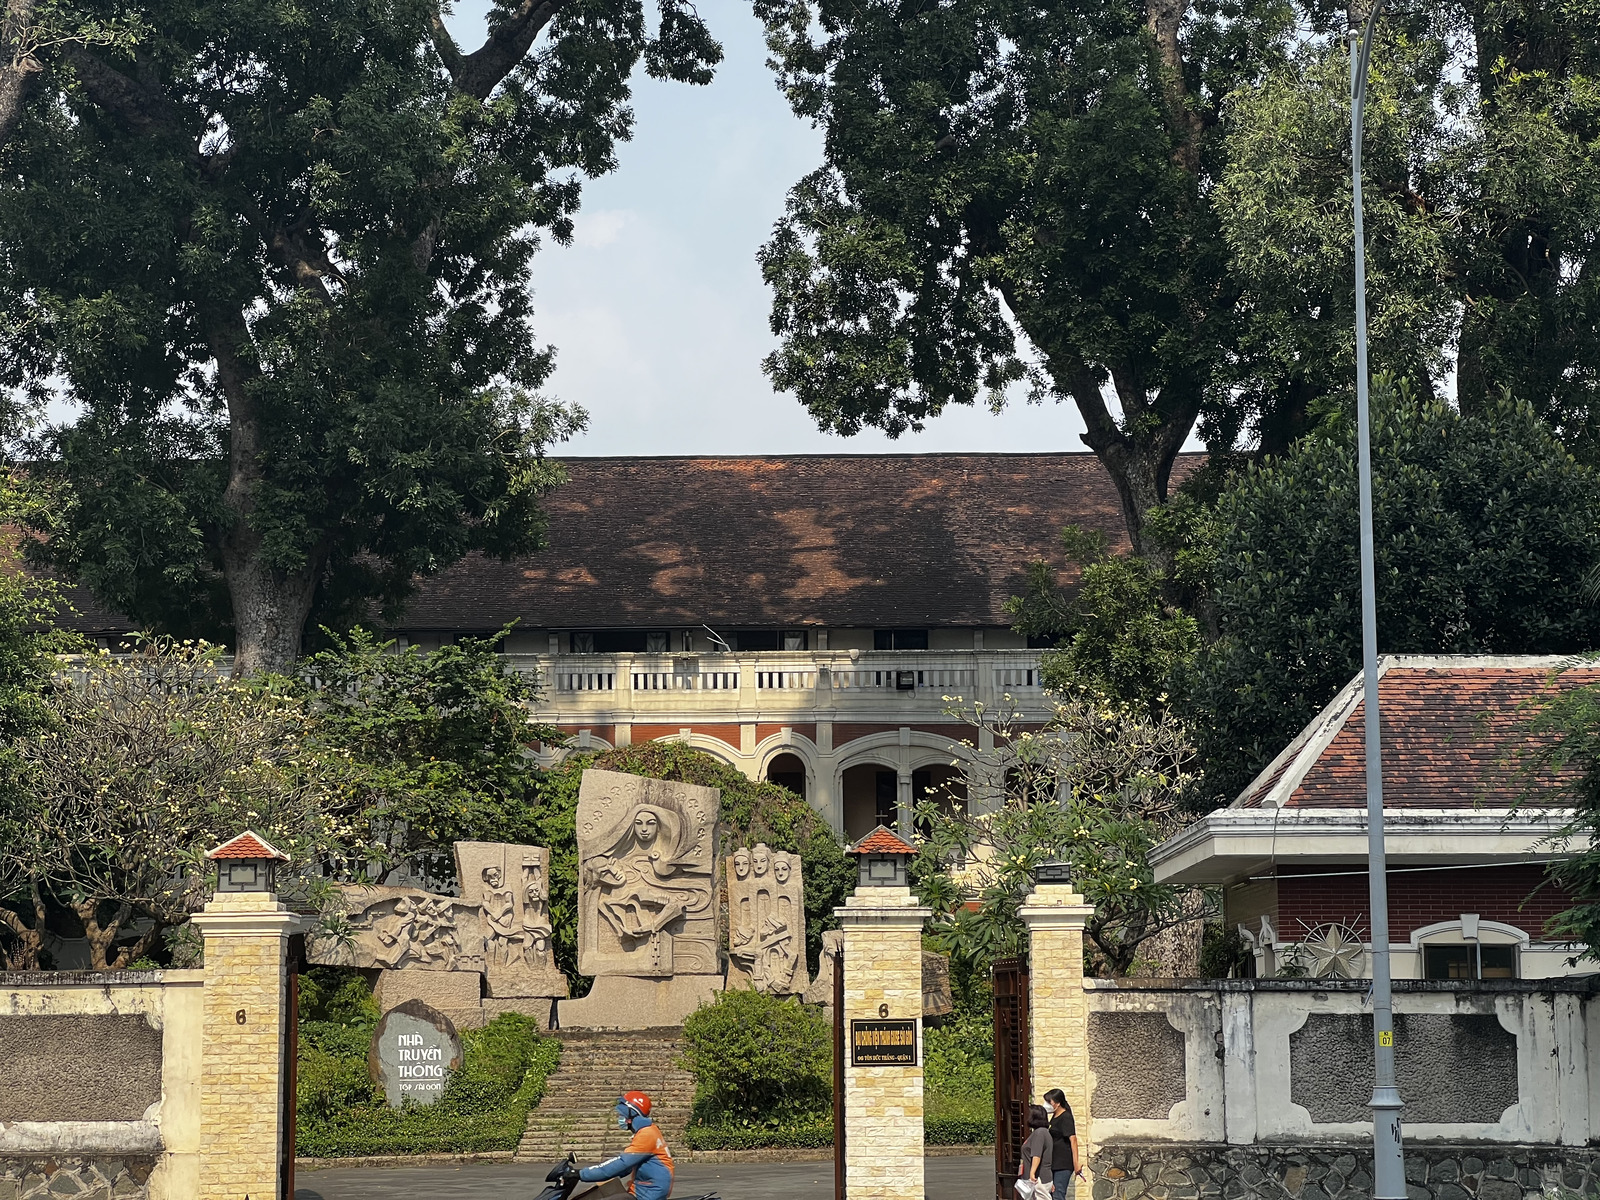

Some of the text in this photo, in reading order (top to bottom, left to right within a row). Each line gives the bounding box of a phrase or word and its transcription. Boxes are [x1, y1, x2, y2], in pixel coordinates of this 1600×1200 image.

[236, 1009, 246, 1025] 6
[879, 1003, 889, 1018] 6
[398, 1032, 423, 1046] NHÀ
[398, 1044, 441, 1061] TRUYỀN
[398, 1061, 443, 1077] THỐNG
